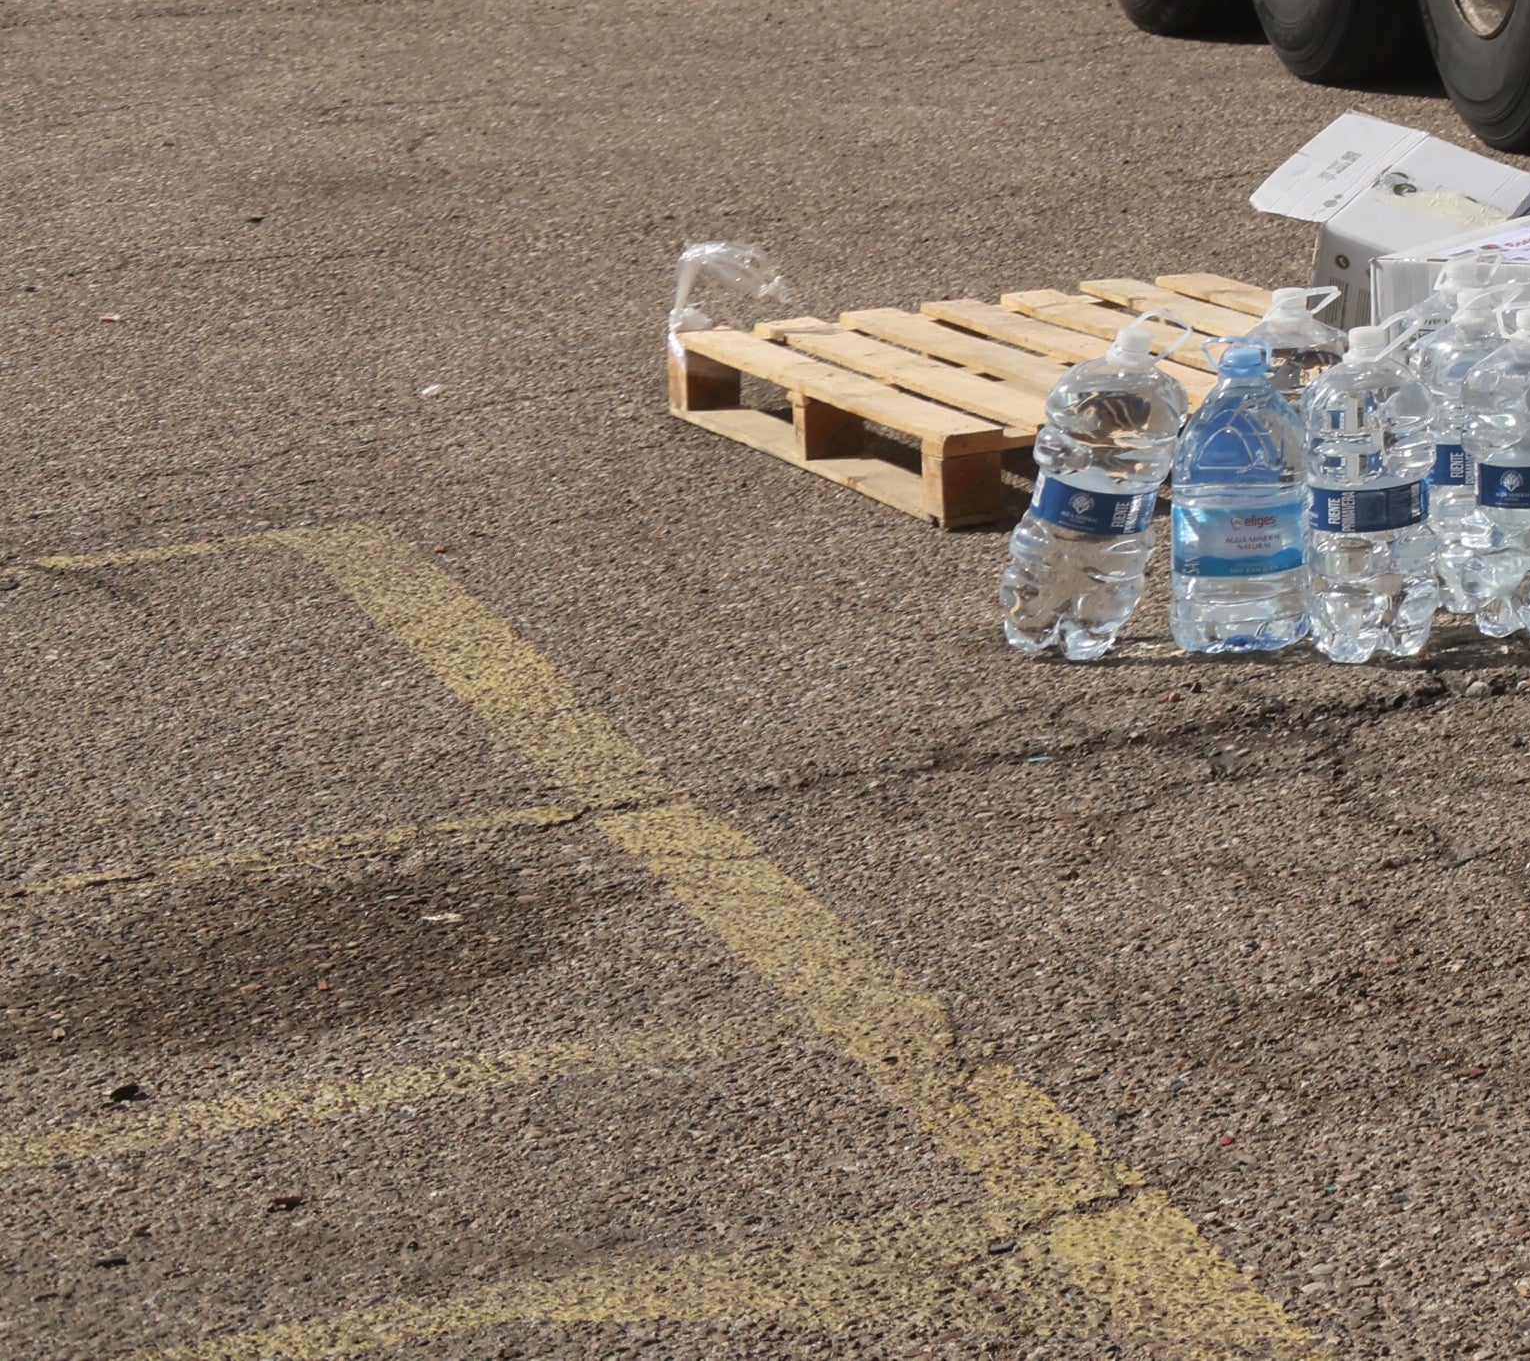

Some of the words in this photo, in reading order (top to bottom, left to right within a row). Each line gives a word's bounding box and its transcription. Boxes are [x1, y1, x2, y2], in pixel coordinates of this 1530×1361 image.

[1111, 501, 1130, 528] FUENTE
[1328, 497, 1341, 525] FUENTE
[1245, 515, 1277, 528] eliges
[1237, 542, 1271, 551] NATURAL
